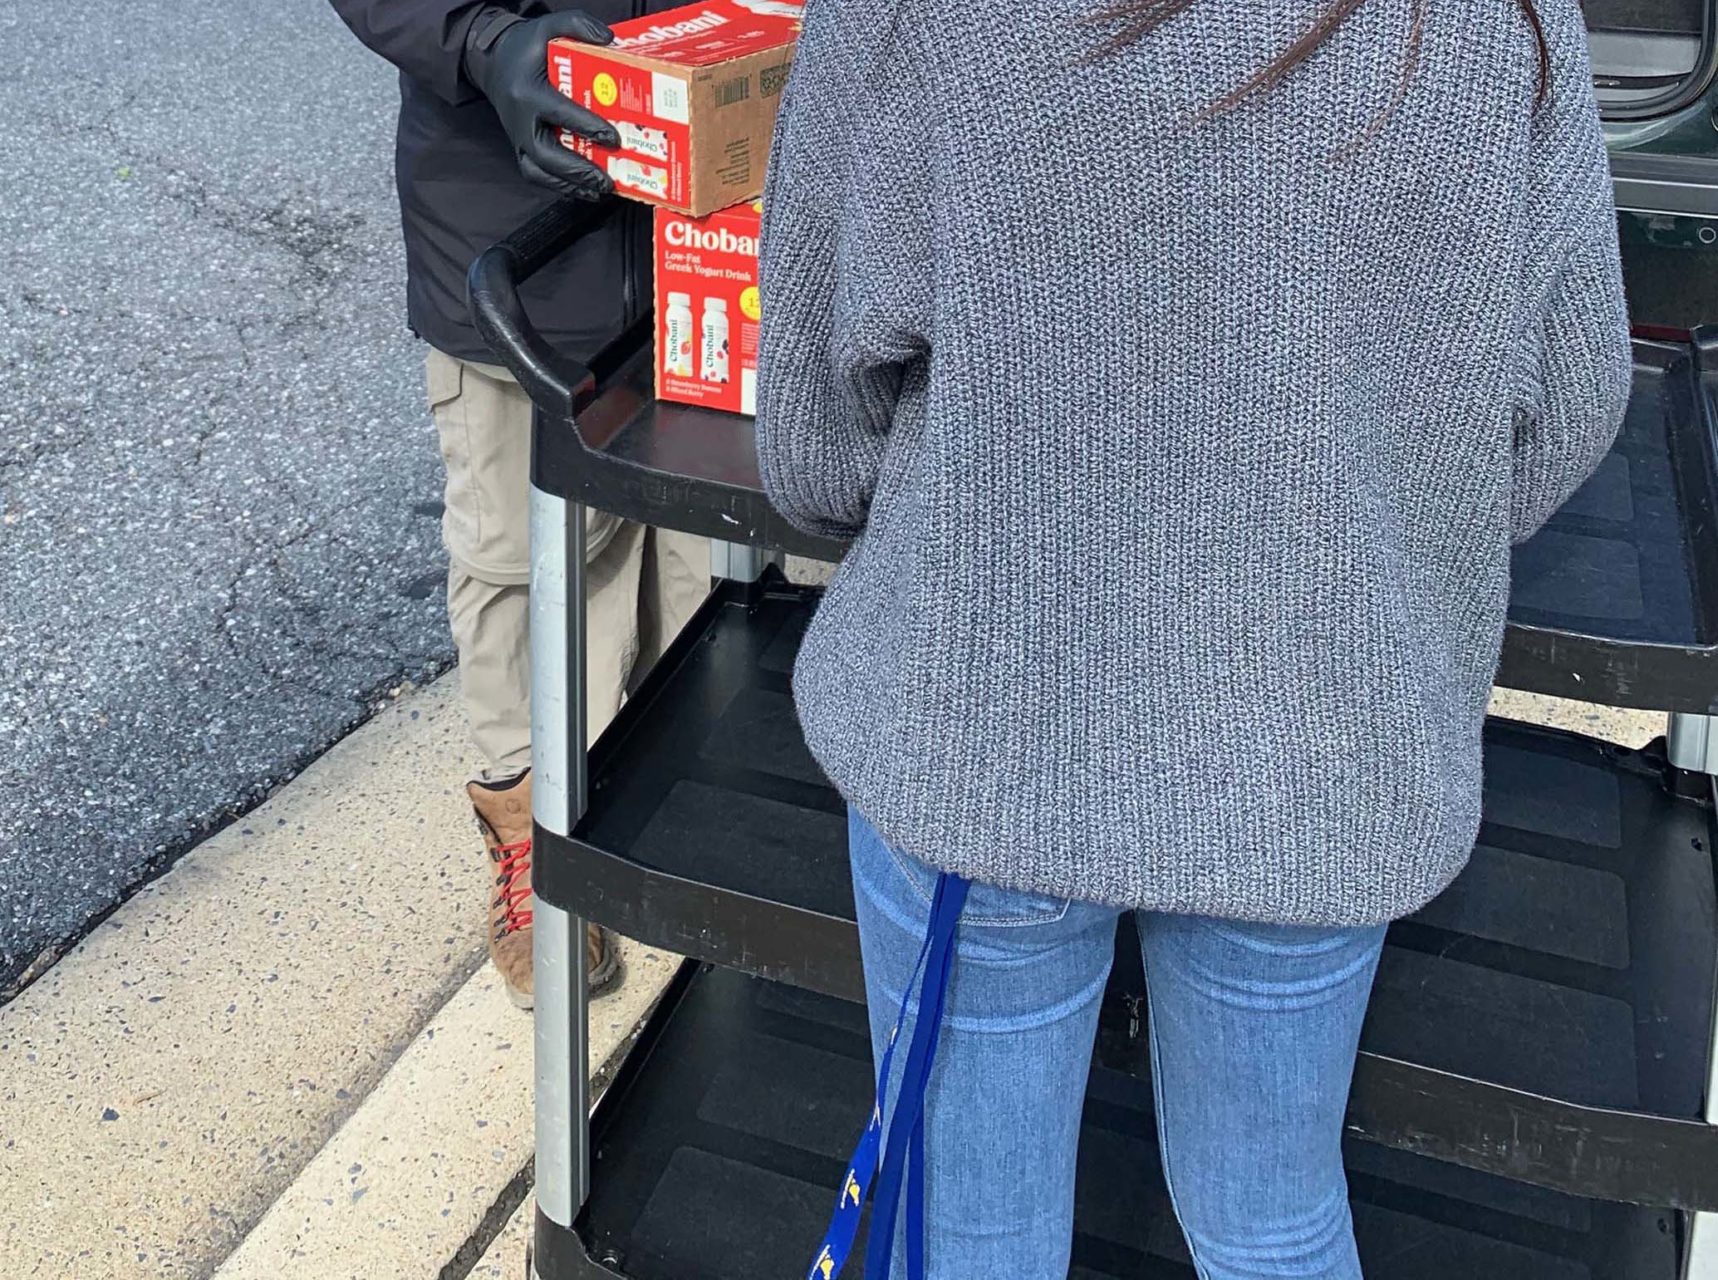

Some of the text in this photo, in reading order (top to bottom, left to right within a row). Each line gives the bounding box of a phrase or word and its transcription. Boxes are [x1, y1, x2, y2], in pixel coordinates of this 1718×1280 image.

[612, 10, 730, 49] hobani
[664, 250, 702, 264] Low-Fat
[664, 261, 752, 282] Greek Yogurt Drink
[669, 318, 678, 363] Chobani
[705, 324, 714, 368] Chobani
